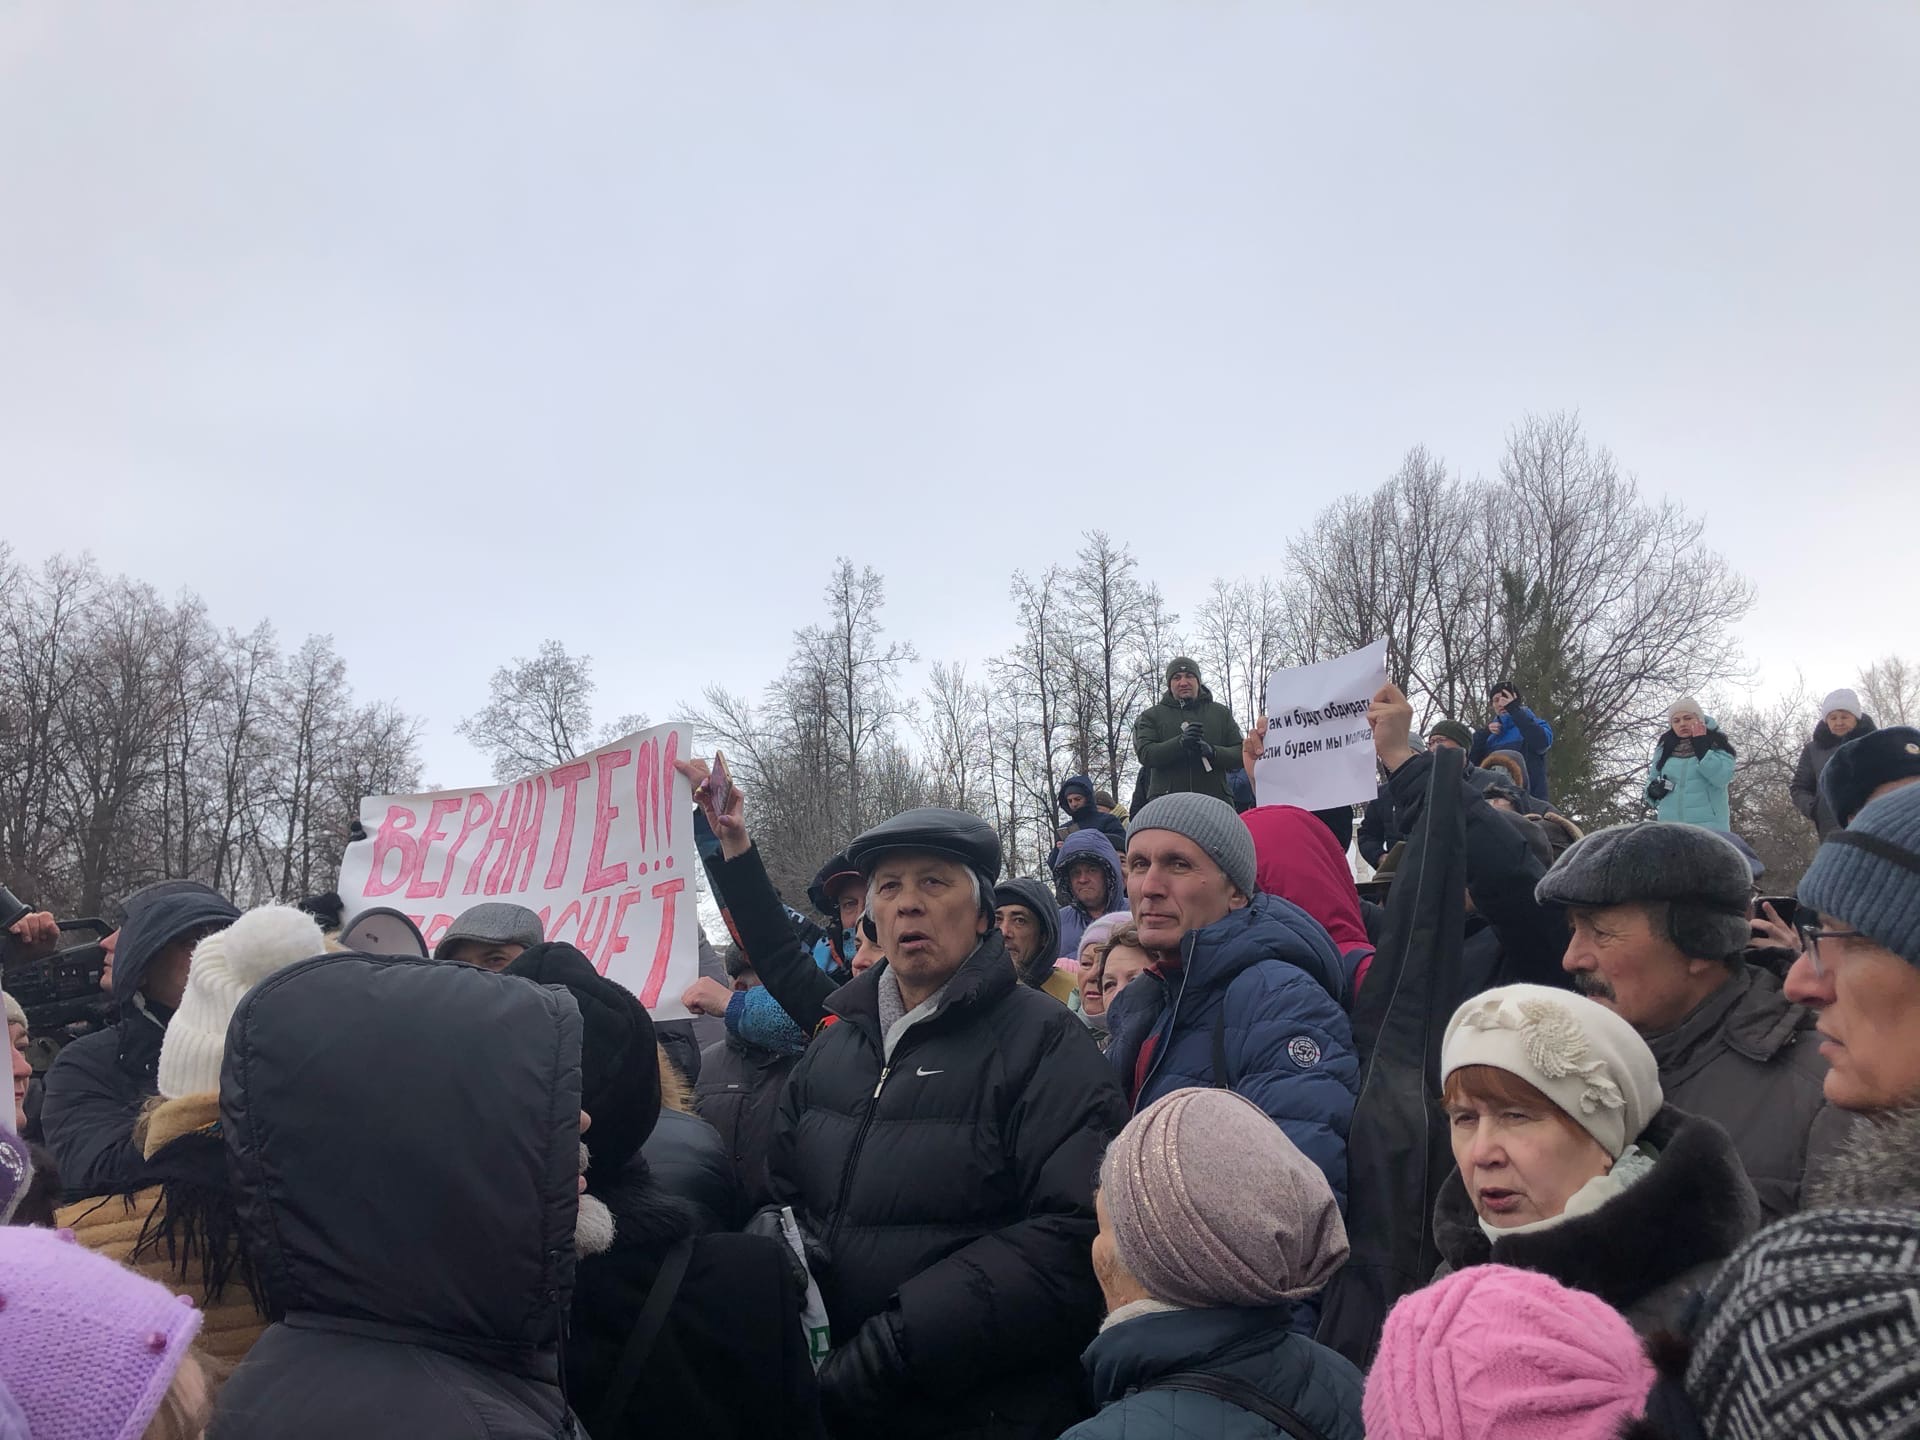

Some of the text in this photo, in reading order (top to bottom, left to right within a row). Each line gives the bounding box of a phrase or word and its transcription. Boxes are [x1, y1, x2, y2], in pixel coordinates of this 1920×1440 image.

[1269, 717, 1283, 730] ак
[1285, 715, 1292, 727] и
[1294, 710, 1323, 728] будут
[1259, 747, 1281, 760] сли
[1285, 738, 1322, 759] будем
[1326, 736, 1342, 750] мы
[364, 731, 678, 898] ВЕРНИТЕ!!!
